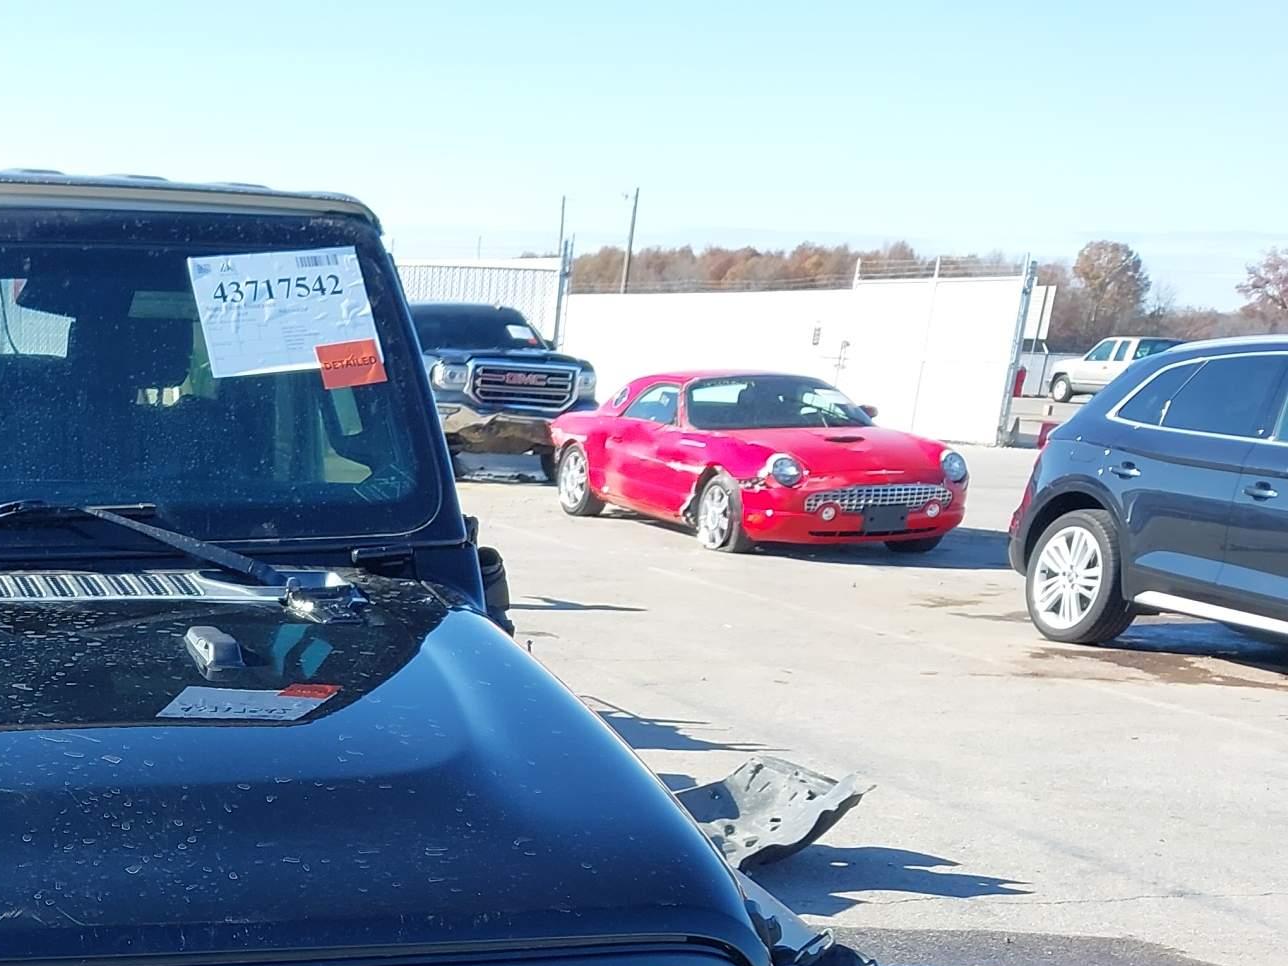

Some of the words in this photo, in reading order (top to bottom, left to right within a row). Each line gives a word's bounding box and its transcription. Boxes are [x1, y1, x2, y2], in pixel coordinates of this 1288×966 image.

[213, 274, 344, 303] 43717542
[323, 355, 377, 370] DETAILED
[505, 372, 548, 386] GMC
